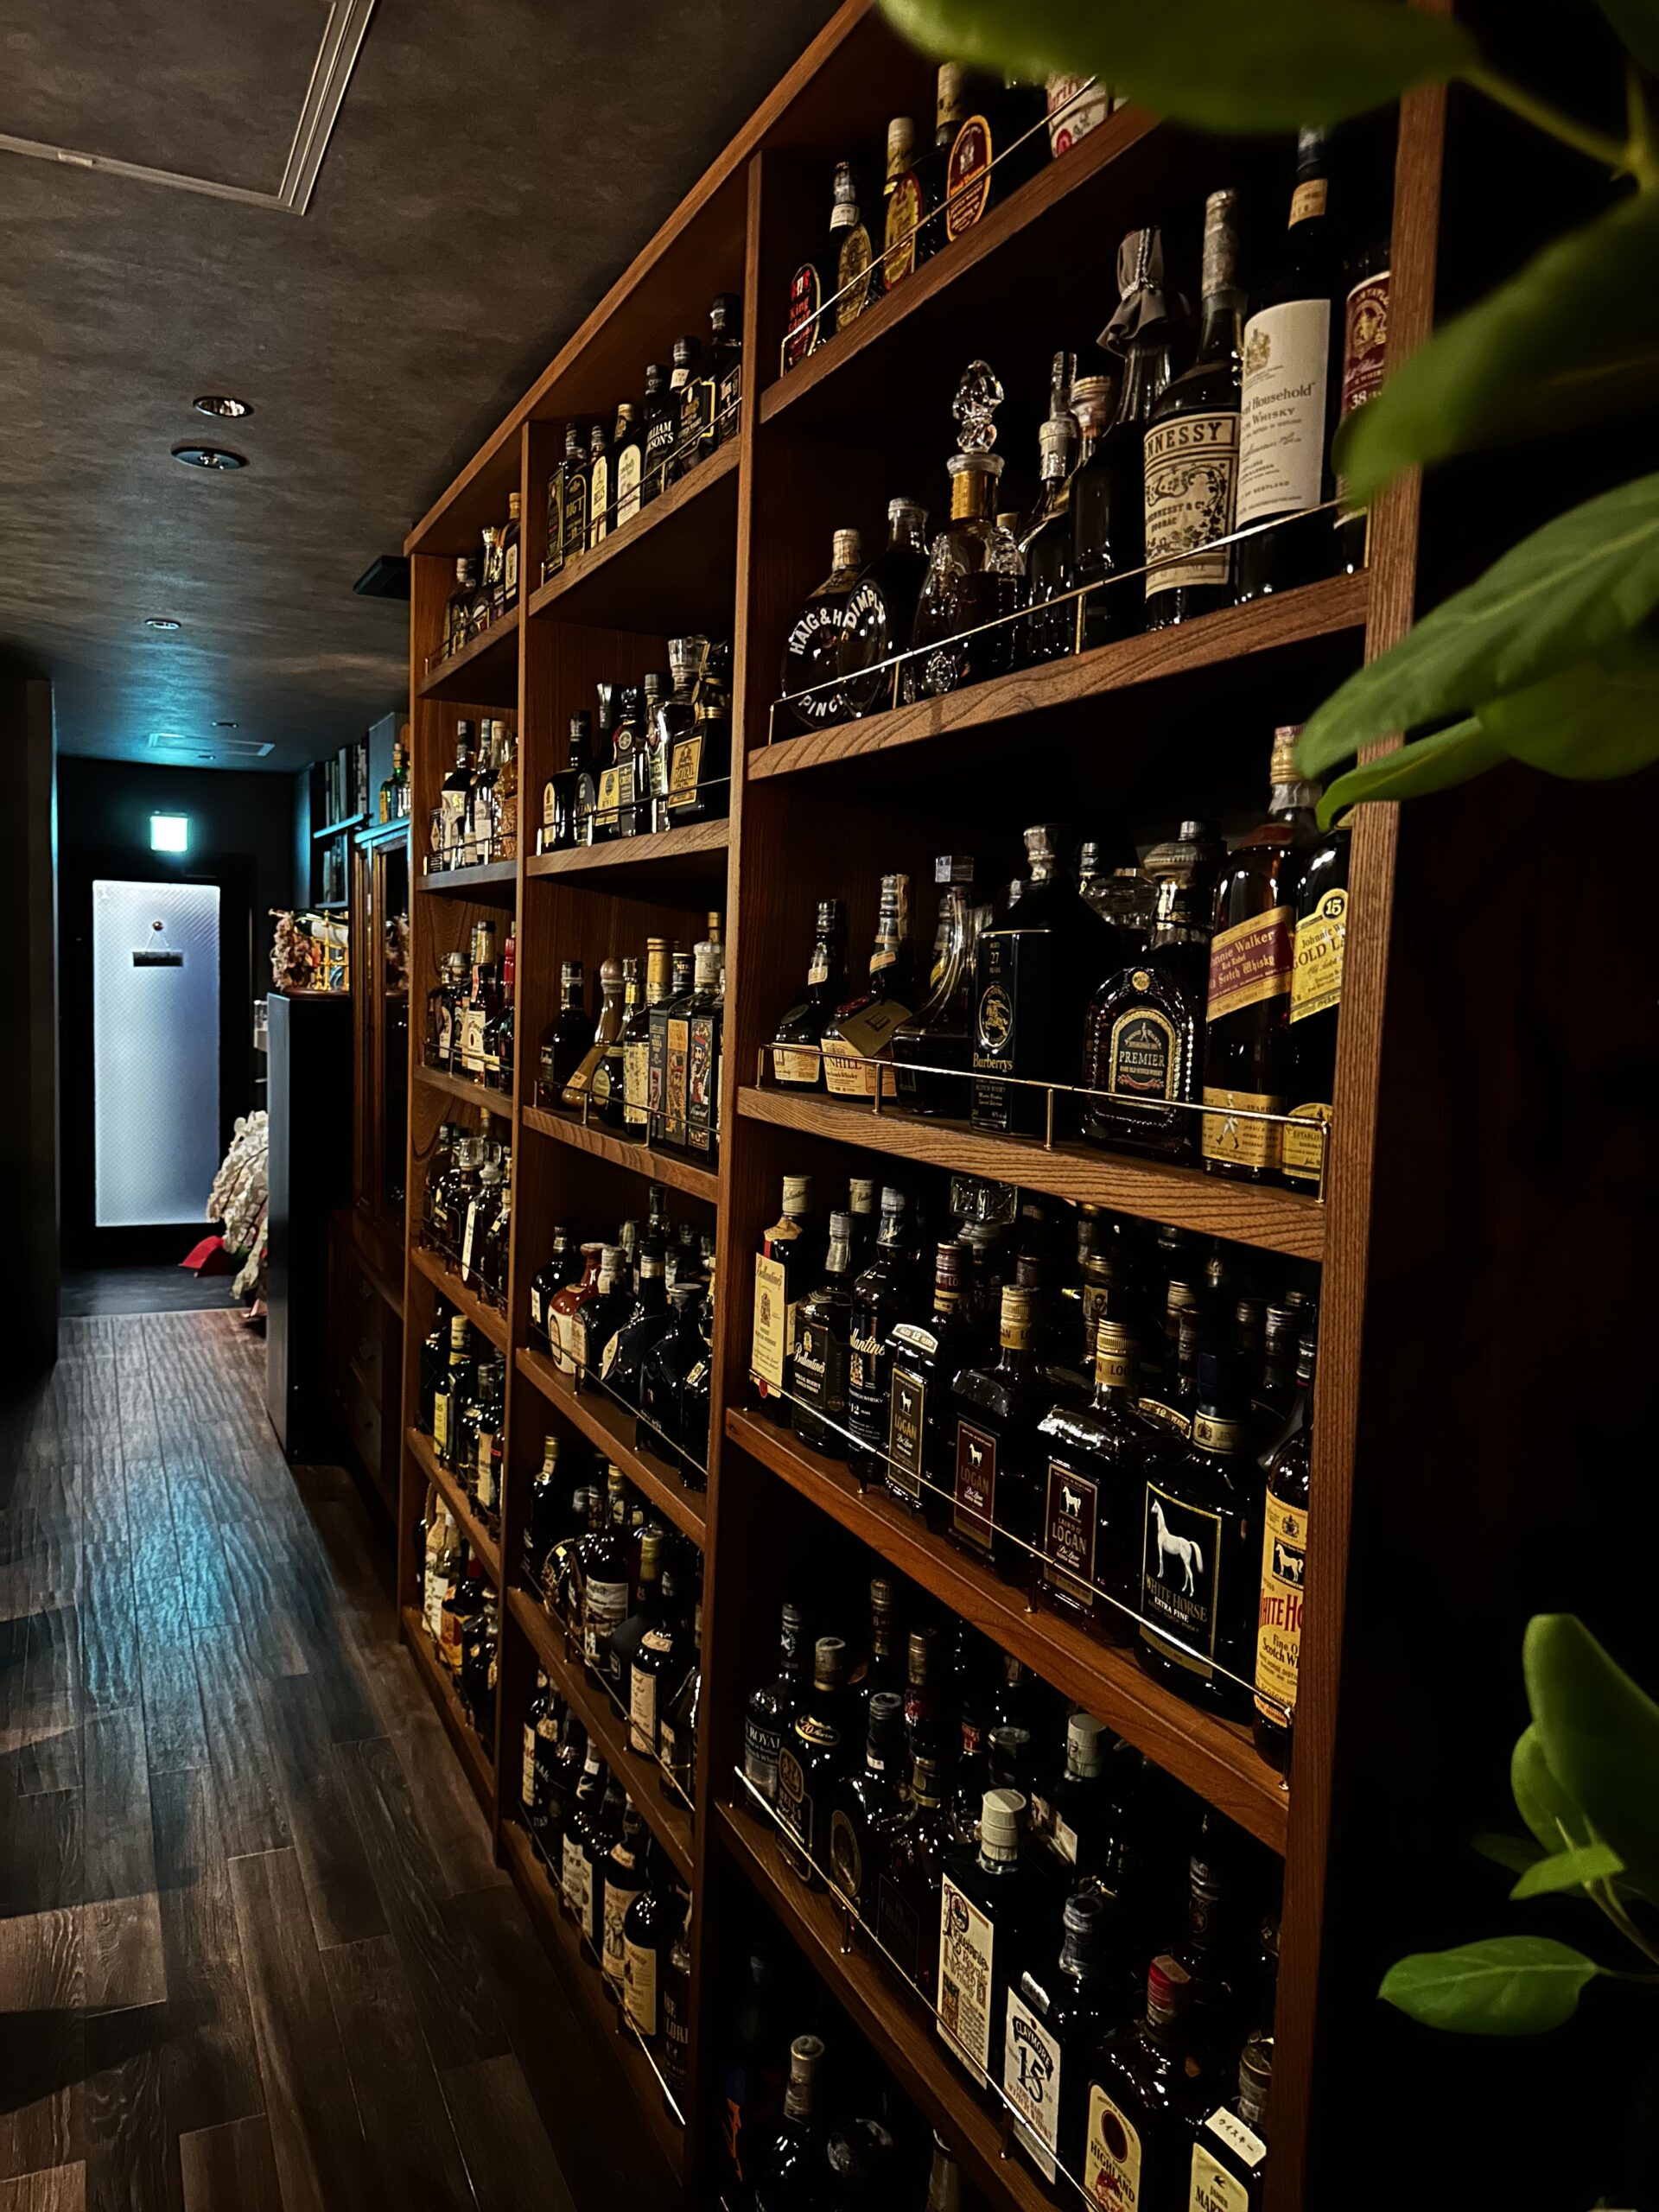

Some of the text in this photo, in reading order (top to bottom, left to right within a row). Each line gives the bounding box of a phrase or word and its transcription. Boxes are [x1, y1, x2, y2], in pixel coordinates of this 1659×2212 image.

[1253, 383, 1313, 410] Household
[1351, 391, 1368, 410] 38
[1252, 407, 1296, 425] WHISKY
[1145, 421, 1223, 462] NNESSY
[788, 613, 822, 656] HAIG
[820, 607, 832, 626] &
[1325, 899, 1342, 916] 15
[1235, 931, 1276, 953] Walker
[1301, 928, 1333, 950] Johnnie
[990, 951, 1000, 965] 27
[1217, 968, 1241, 985] Scotch
[1243, 954, 1275, 975] Whisky
[973, 1052, 1014, 1073] Burberrys
[1119, 1050, 1166, 1068] PREMIER
[911, 1329, 921, 1341] 12
[850, 1402, 861, 1415] 12
[1155, 1407, 1166, 1418] 12
[1170, 1414, 1187, 1430] YEARS
[894, 1413, 918, 1440] LOGAN
[960, 1465, 990, 1495] LOGAN
[1058, 1516, 1076, 1531] LAIRD
[1052, 1522, 1087, 1555] LOGAN
[1146, 1573, 1208, 1623] WHITE HORSE
[1154, 1595, 1190, 1624] EXTRA FINE
[1262, 1637, 1285, 1663] Scotch
[1273, 1633, 1288, 1651] Fine
[800, 1723, 814, 1735] 20
[1015, 2019, 1051, 2072] CLAYMORE
[1017, 2045, 1046, 2104] 15
[1090, 2139, 1135, 2203] HIGHLAND
